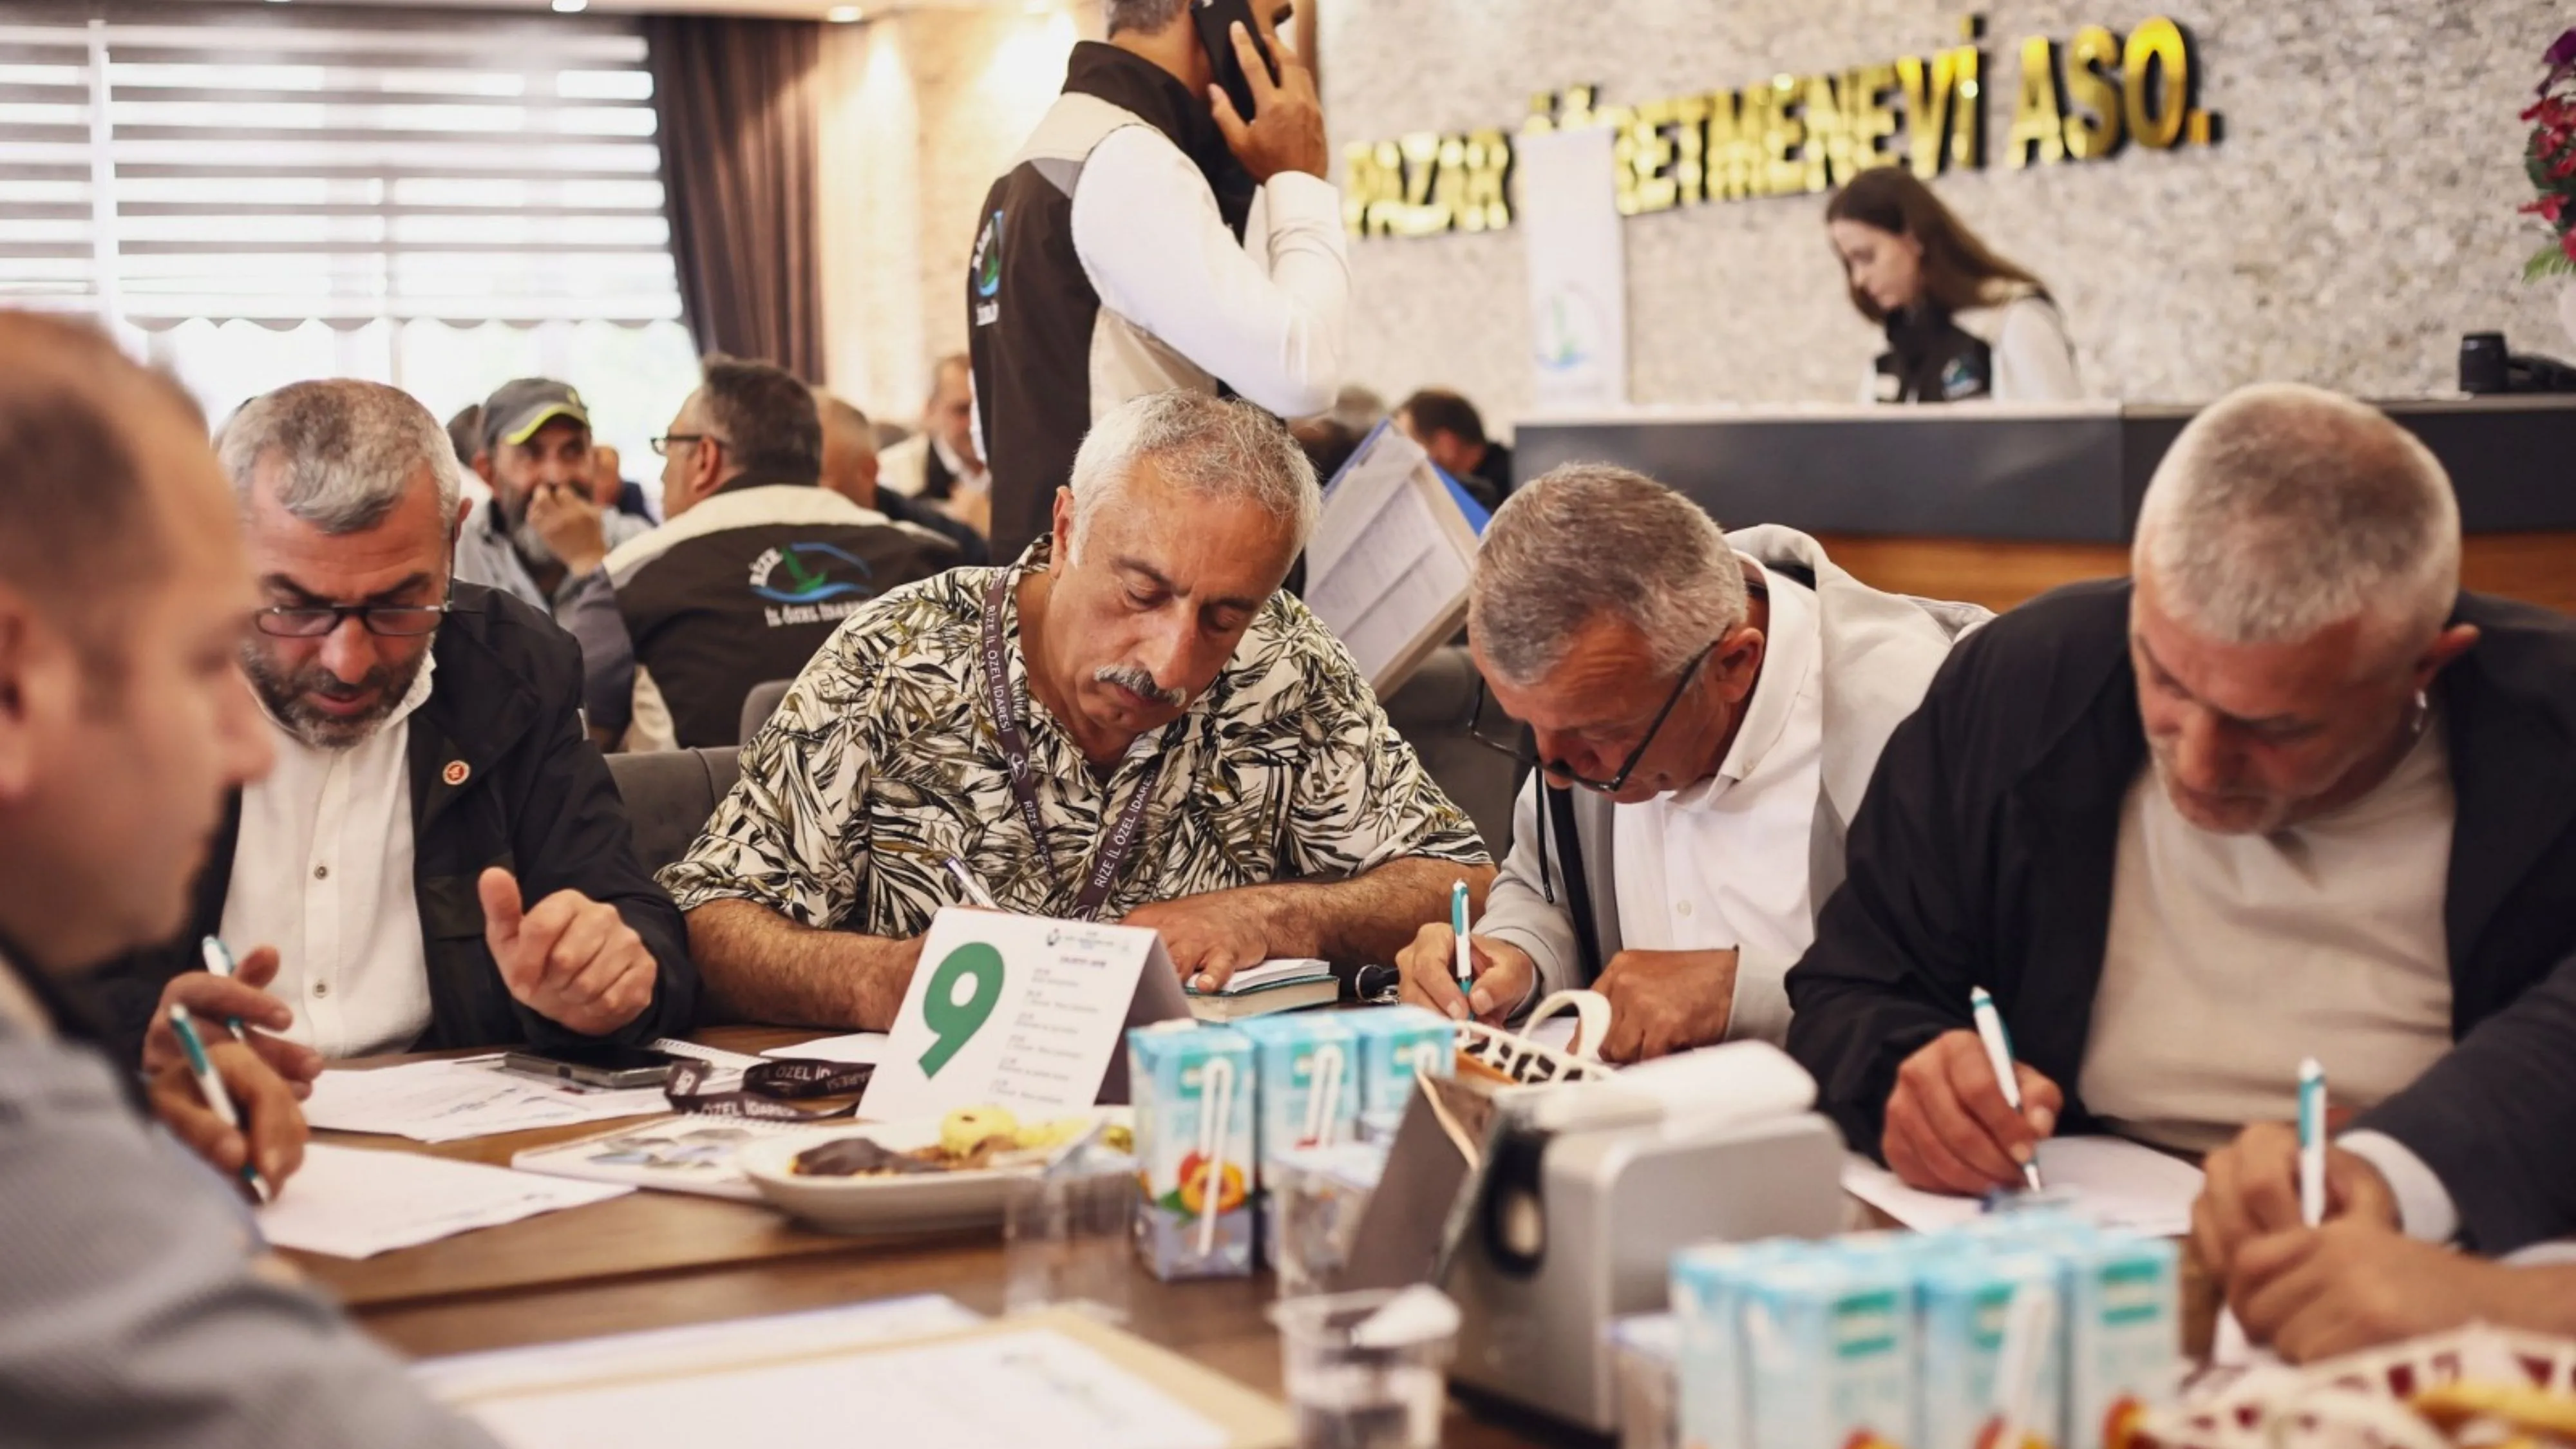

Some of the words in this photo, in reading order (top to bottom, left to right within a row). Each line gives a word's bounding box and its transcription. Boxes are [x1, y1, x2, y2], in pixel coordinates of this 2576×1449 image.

[2005, 15, 2219, 169] ASO.
[1094, 858, 1115, 889] RİZE
[1113, 815, 1136, 847] ÖZEL
[918, 942, 1005, 1080] 9
